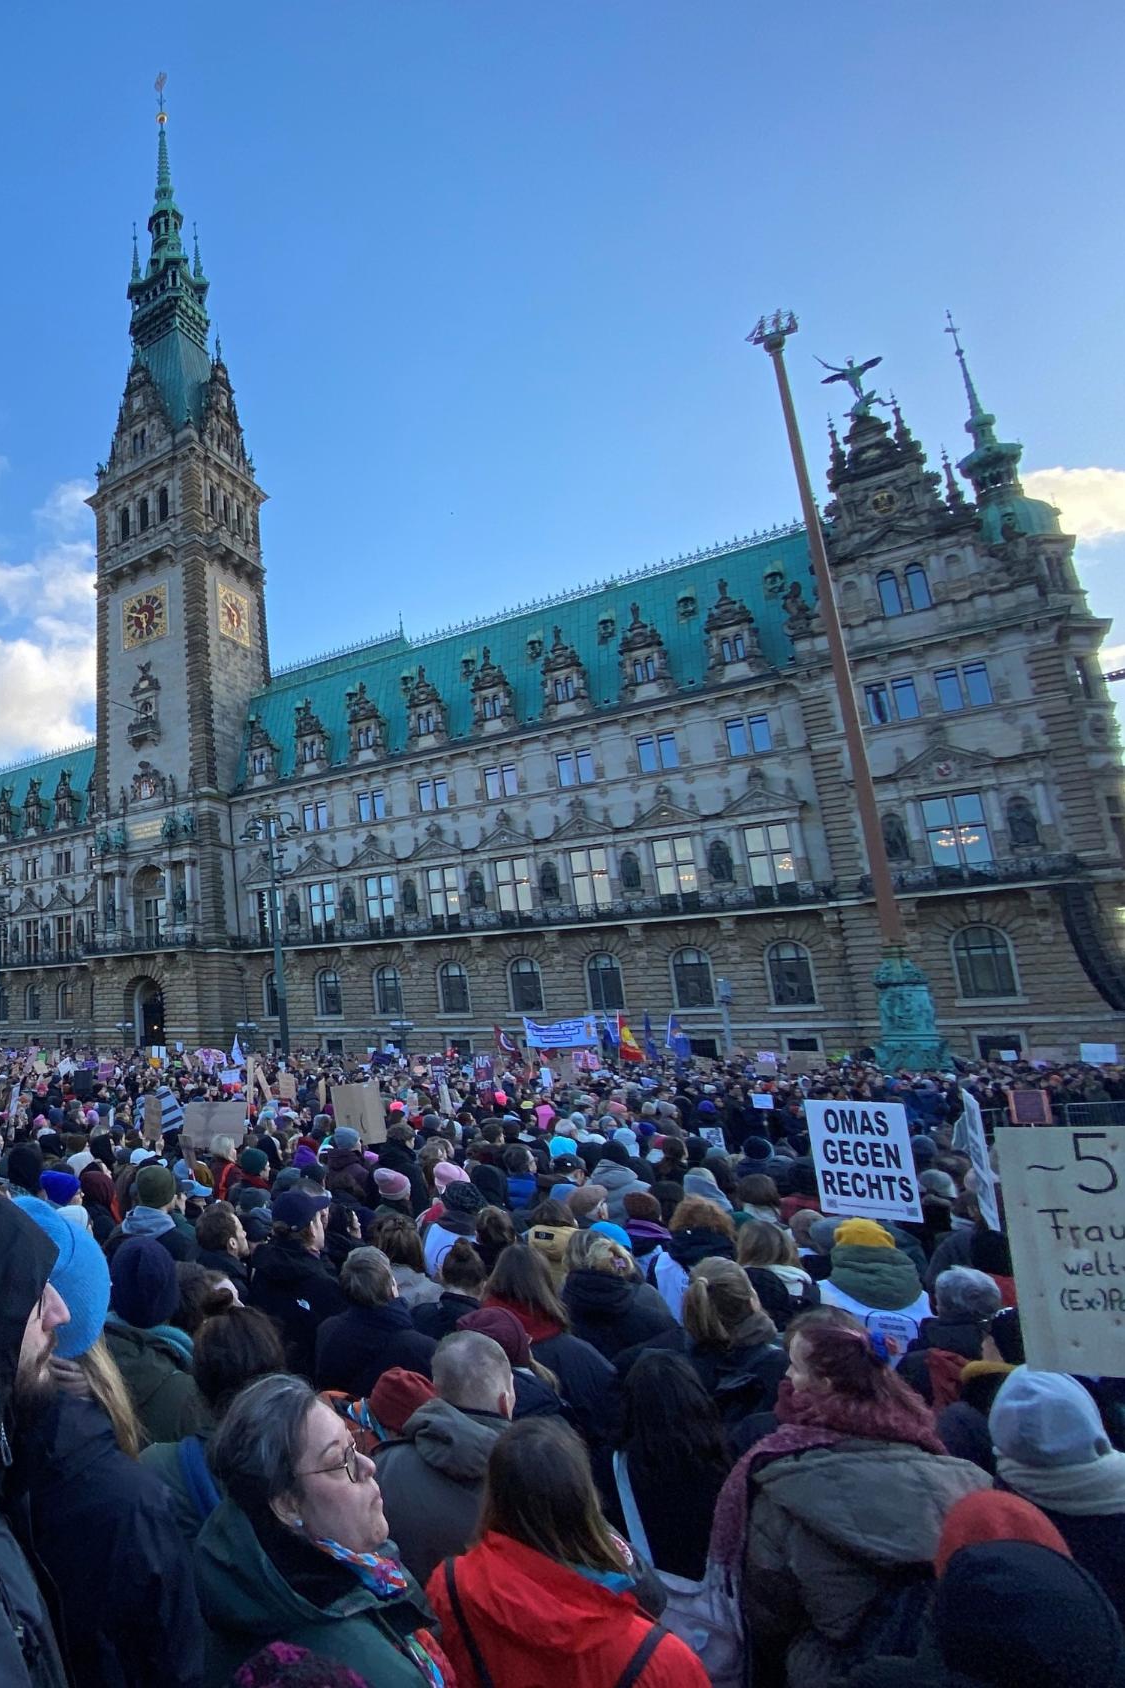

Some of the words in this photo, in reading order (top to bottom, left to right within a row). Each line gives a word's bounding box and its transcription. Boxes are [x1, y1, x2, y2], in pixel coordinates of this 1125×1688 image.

[824, 1108, 889, 1137] OMAS
[823, 1139, 902, 1169] GEGEN
[821, 1170, 914, 1203] RECHTS
